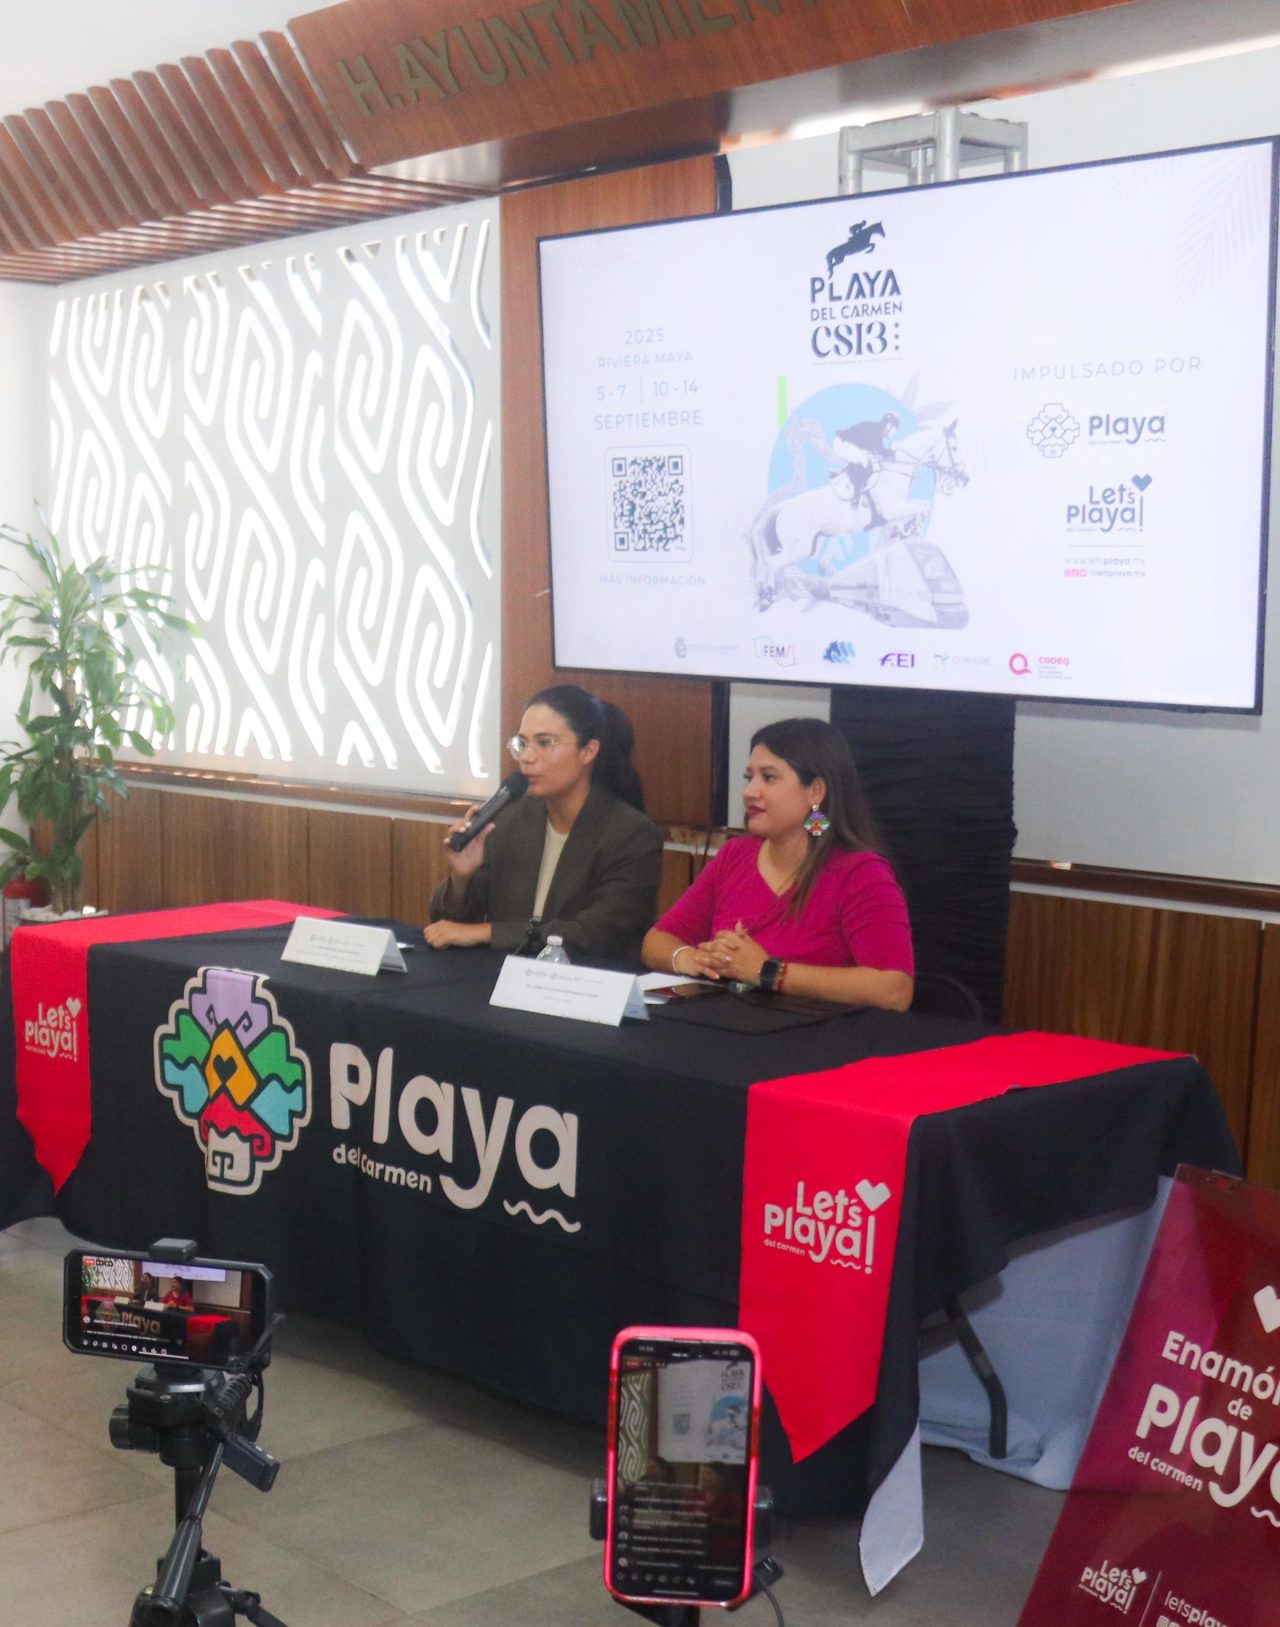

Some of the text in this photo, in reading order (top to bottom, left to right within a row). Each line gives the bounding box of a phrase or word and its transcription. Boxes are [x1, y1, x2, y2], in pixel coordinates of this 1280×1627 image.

[810, 269, 901, 304] PLAYA
[811, 302, 902, 321] DEL CARMEN
[624, 327, 665, 345] 2025
[598, 350, 694, 369] RIVIERA MAYA
[1014, 356, 1201, 382] IMPULSADO POR
[594, 409, 703, 430] SEPTIEMBRE
[1088, 413, 1165, 445] Playa
[1038, 656, 1070, 667] CODEQ
[329, 1042, 579, 1210] Playa
[332, 1143, 360, 1168] del
[1227, 1398, 1253, 1421] de
[1128, 1446, 1151, 1465] del
[1164, 1590, 1227, 1627] letspla
